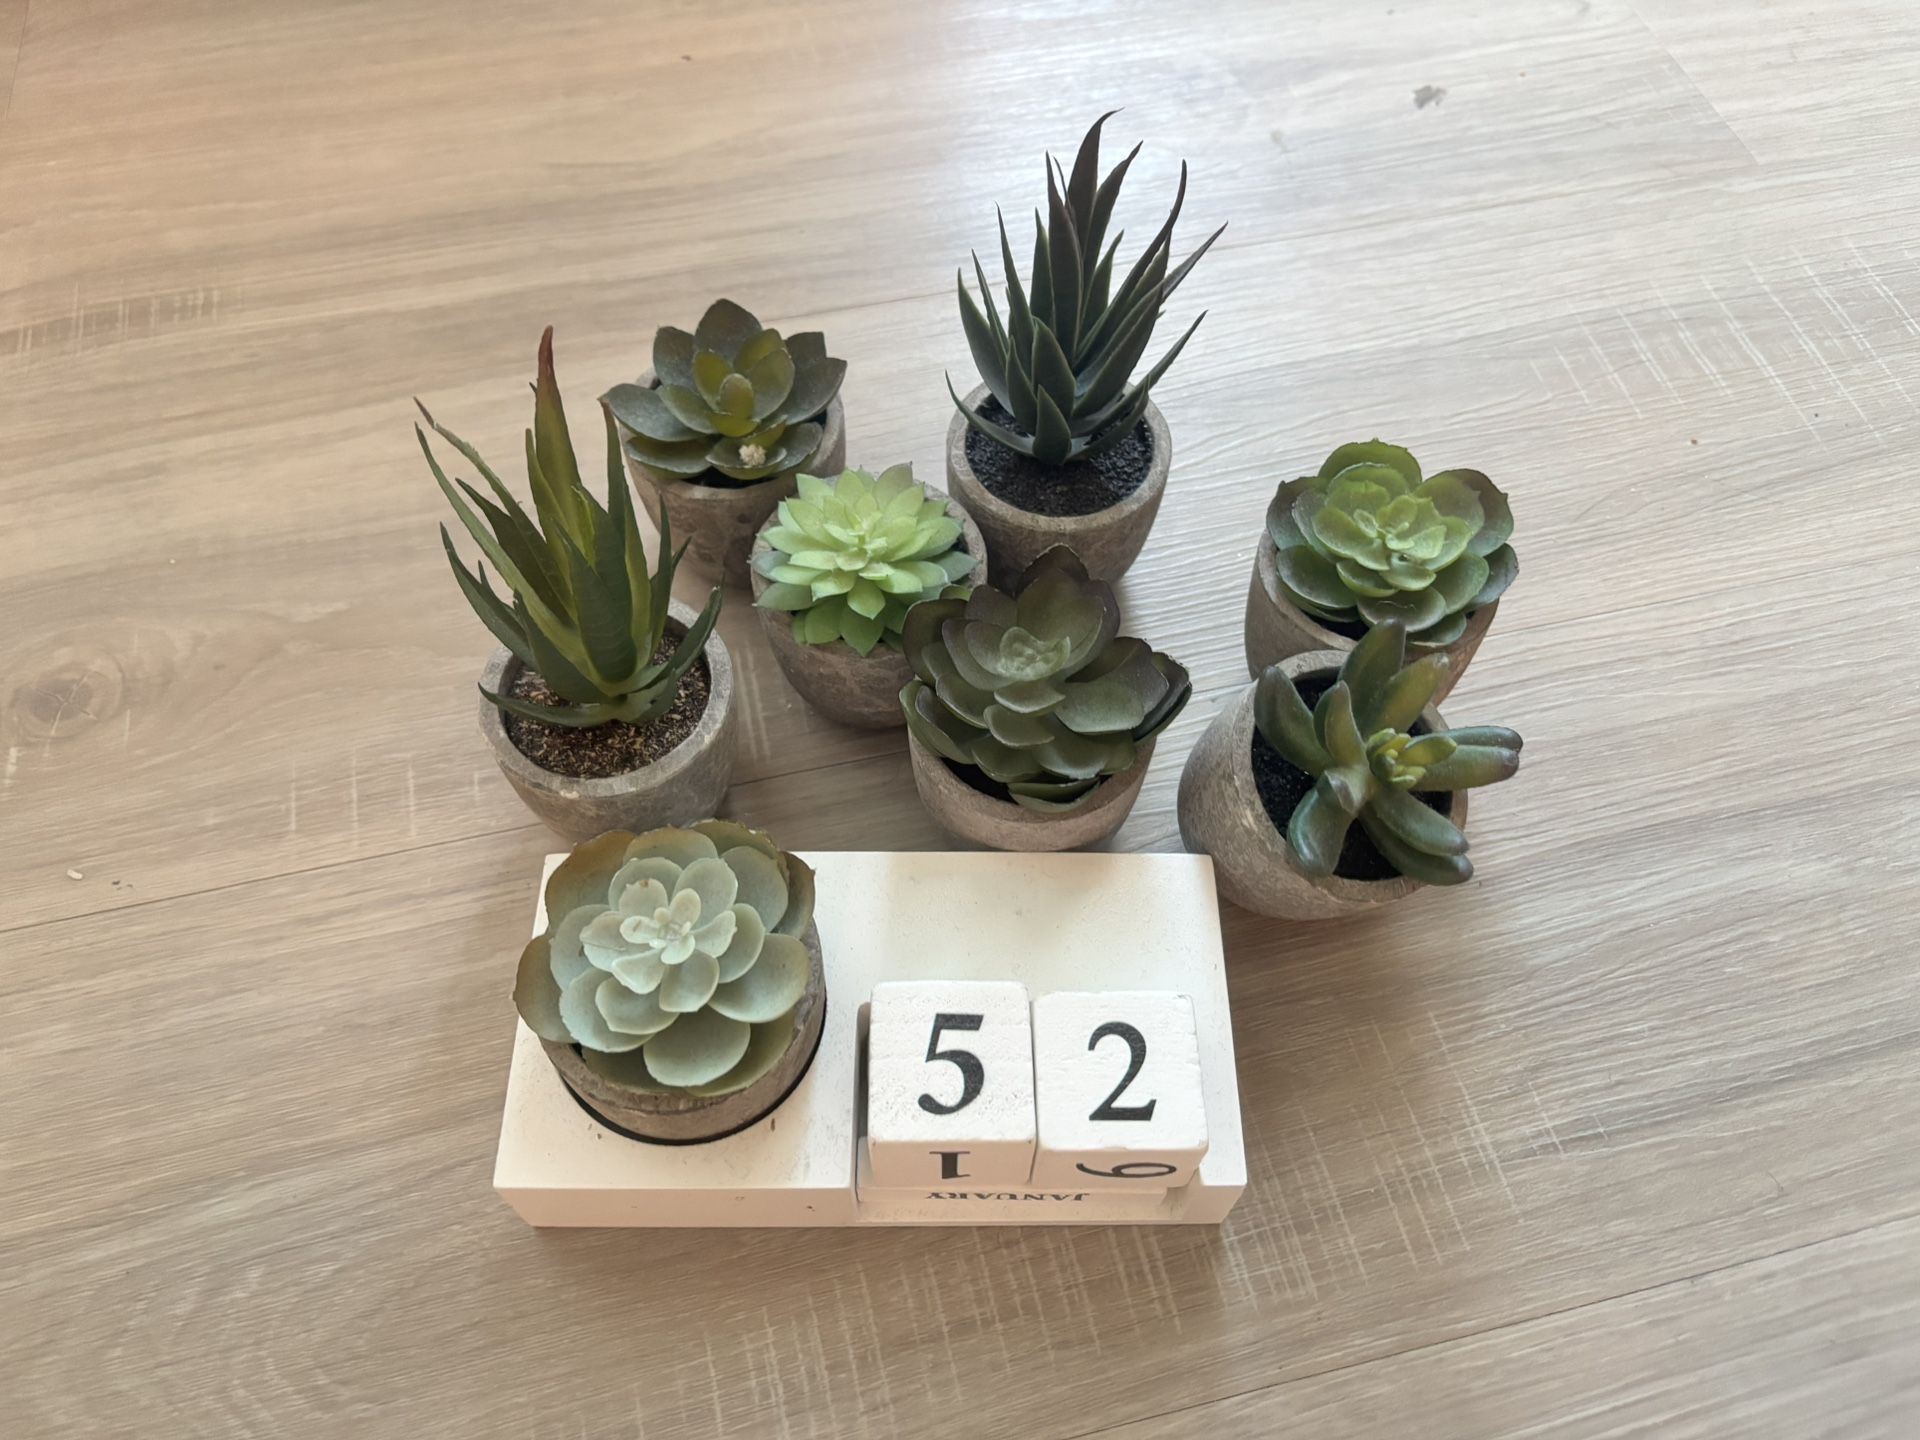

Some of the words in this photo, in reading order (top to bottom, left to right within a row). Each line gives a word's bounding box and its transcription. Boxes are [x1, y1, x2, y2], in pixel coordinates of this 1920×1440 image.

[917, 1012, 985, 1115] 5
[1087, 1020, 1157, 1121] 2
[926, 1191, 1090, 1202] JANUARY
[928, 1150, 971, 1180] 1
